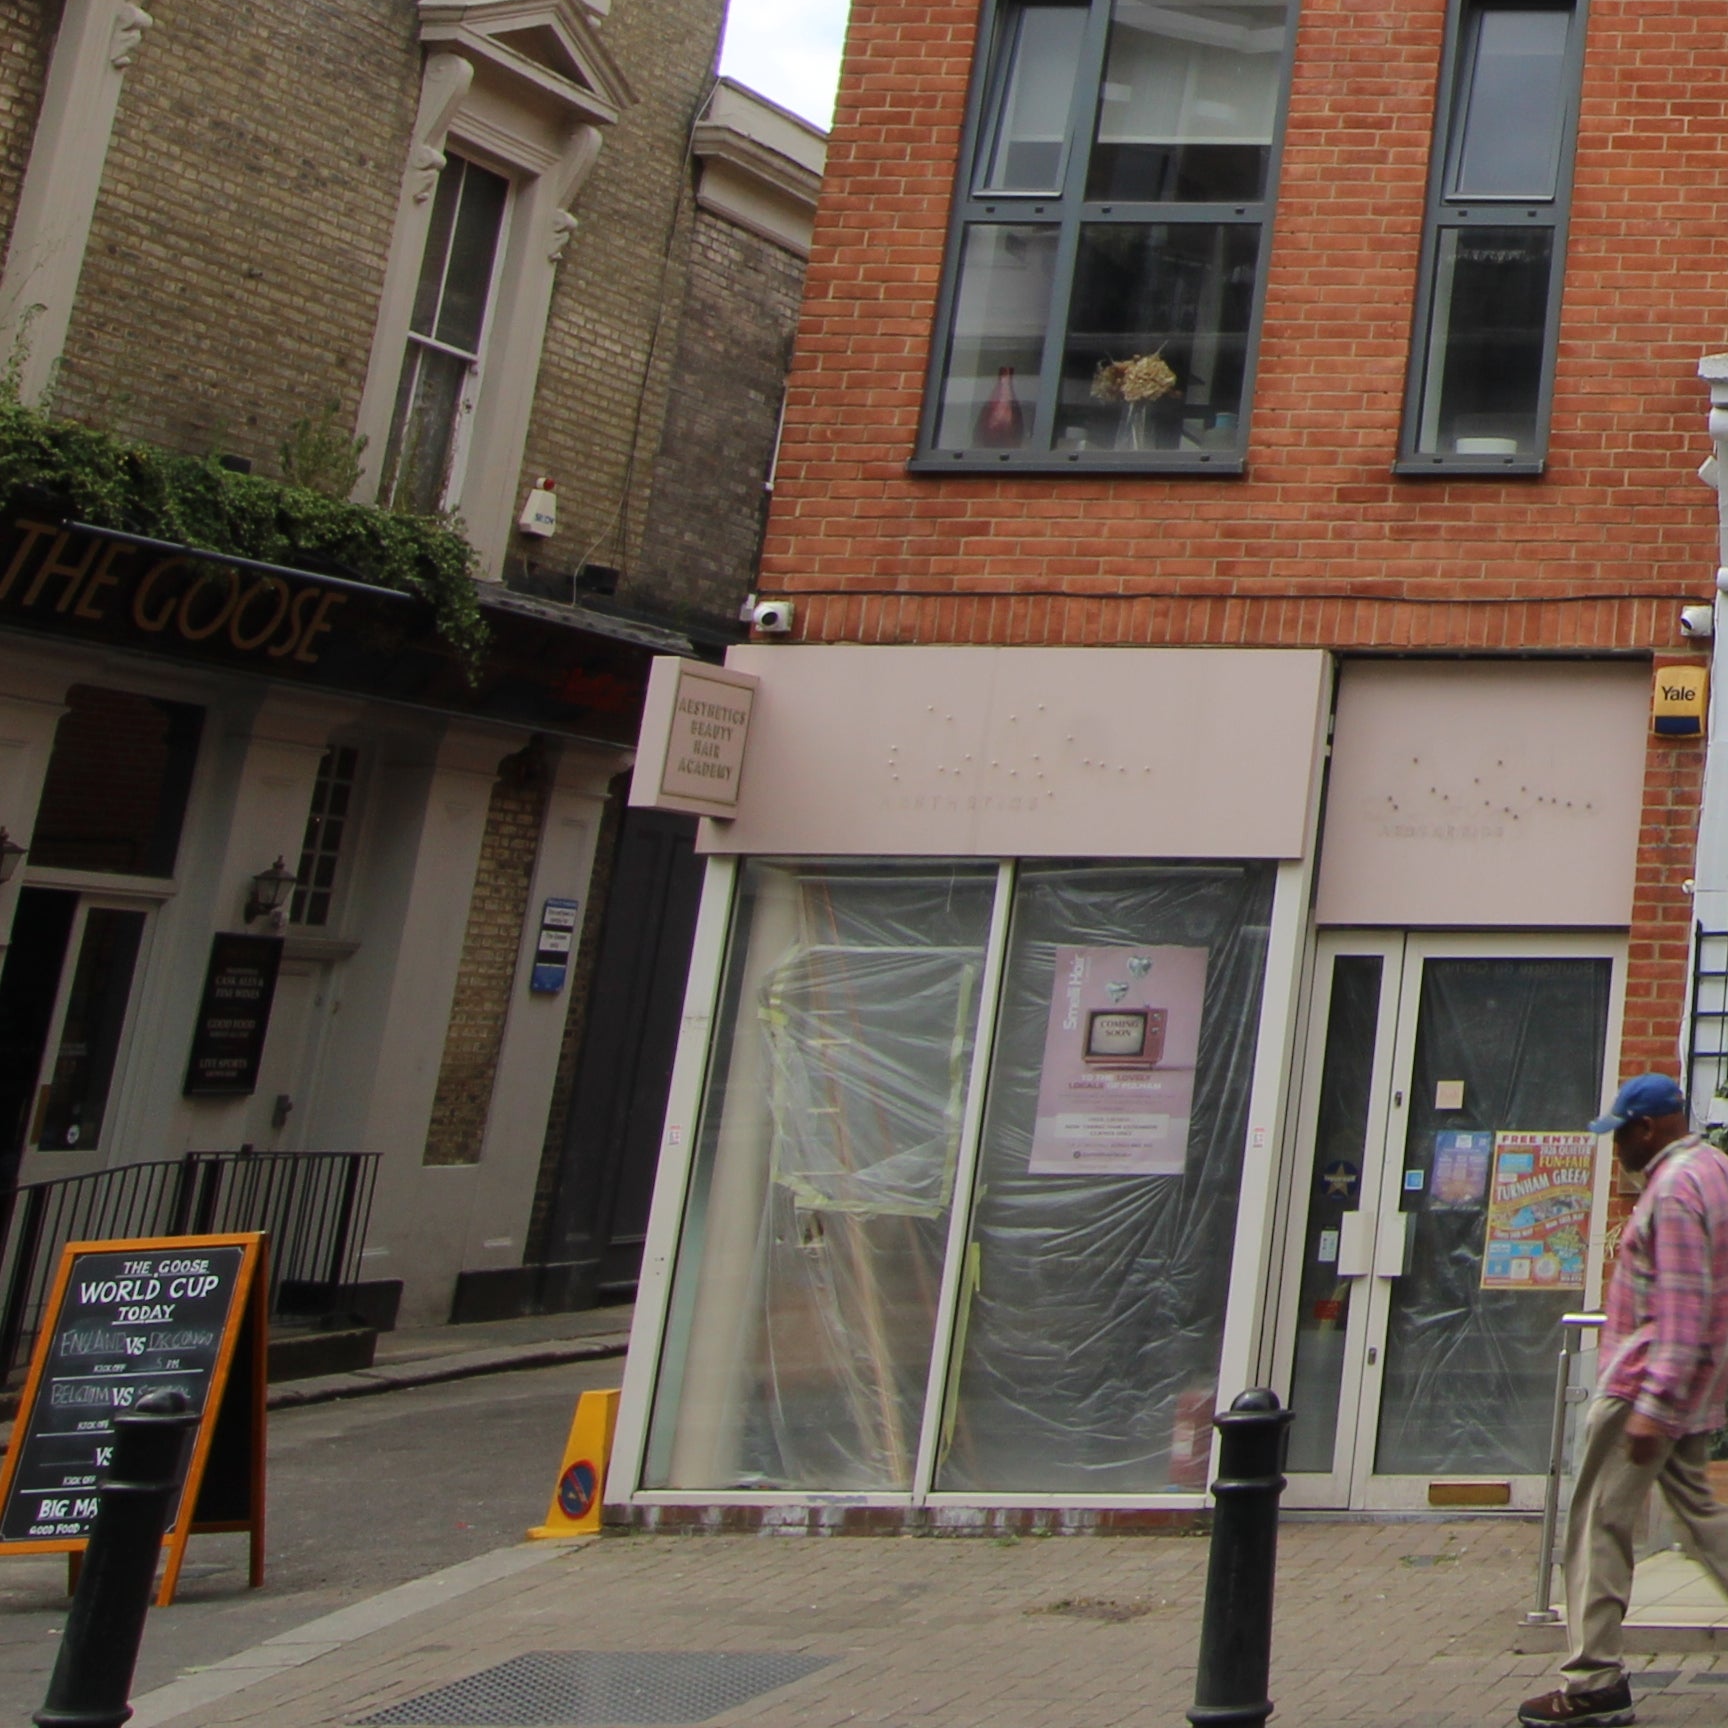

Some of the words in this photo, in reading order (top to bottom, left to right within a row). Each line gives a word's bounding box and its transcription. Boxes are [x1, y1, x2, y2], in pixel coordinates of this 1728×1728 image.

[0, 519, 137, 619] THE
[133, 556, 347, 663] GOOSE
[1661, 684, 1696, 702] Yale
[678, 697, 747, 726] AESTHETICS
[690, 719, 733, 742] BEAUTY
[693, 739, 720, 759] HAIR
[678, 757, 731, 780] ACADEMY
[1105, 1029, 1132, 1037] SOON
[1502, 1135, 1536, 1143] FREE
[1542, 1135, 1591, 1144] ENTRY
[1552, 1168, 1591, 1185] GREEN
[123, 1260, 152, 1275] THE
[158, 1259, 210, 1274] GOOSE
[80, 1279, 161, 1304] WORLD
[169, 1275, 219, 1299] CUP
[117, 1304, 176, 1321] TODAY
[125, 1337, 147, 1355] VS
[112, 1387, 134, 1407] VS
[95, 1446, 113, 1466] VS
[39, 1499, 69, 1518] BIG
[29, 1525, 54, 1535] GOOD
[56, 1523, 80, 1535] FOOD
